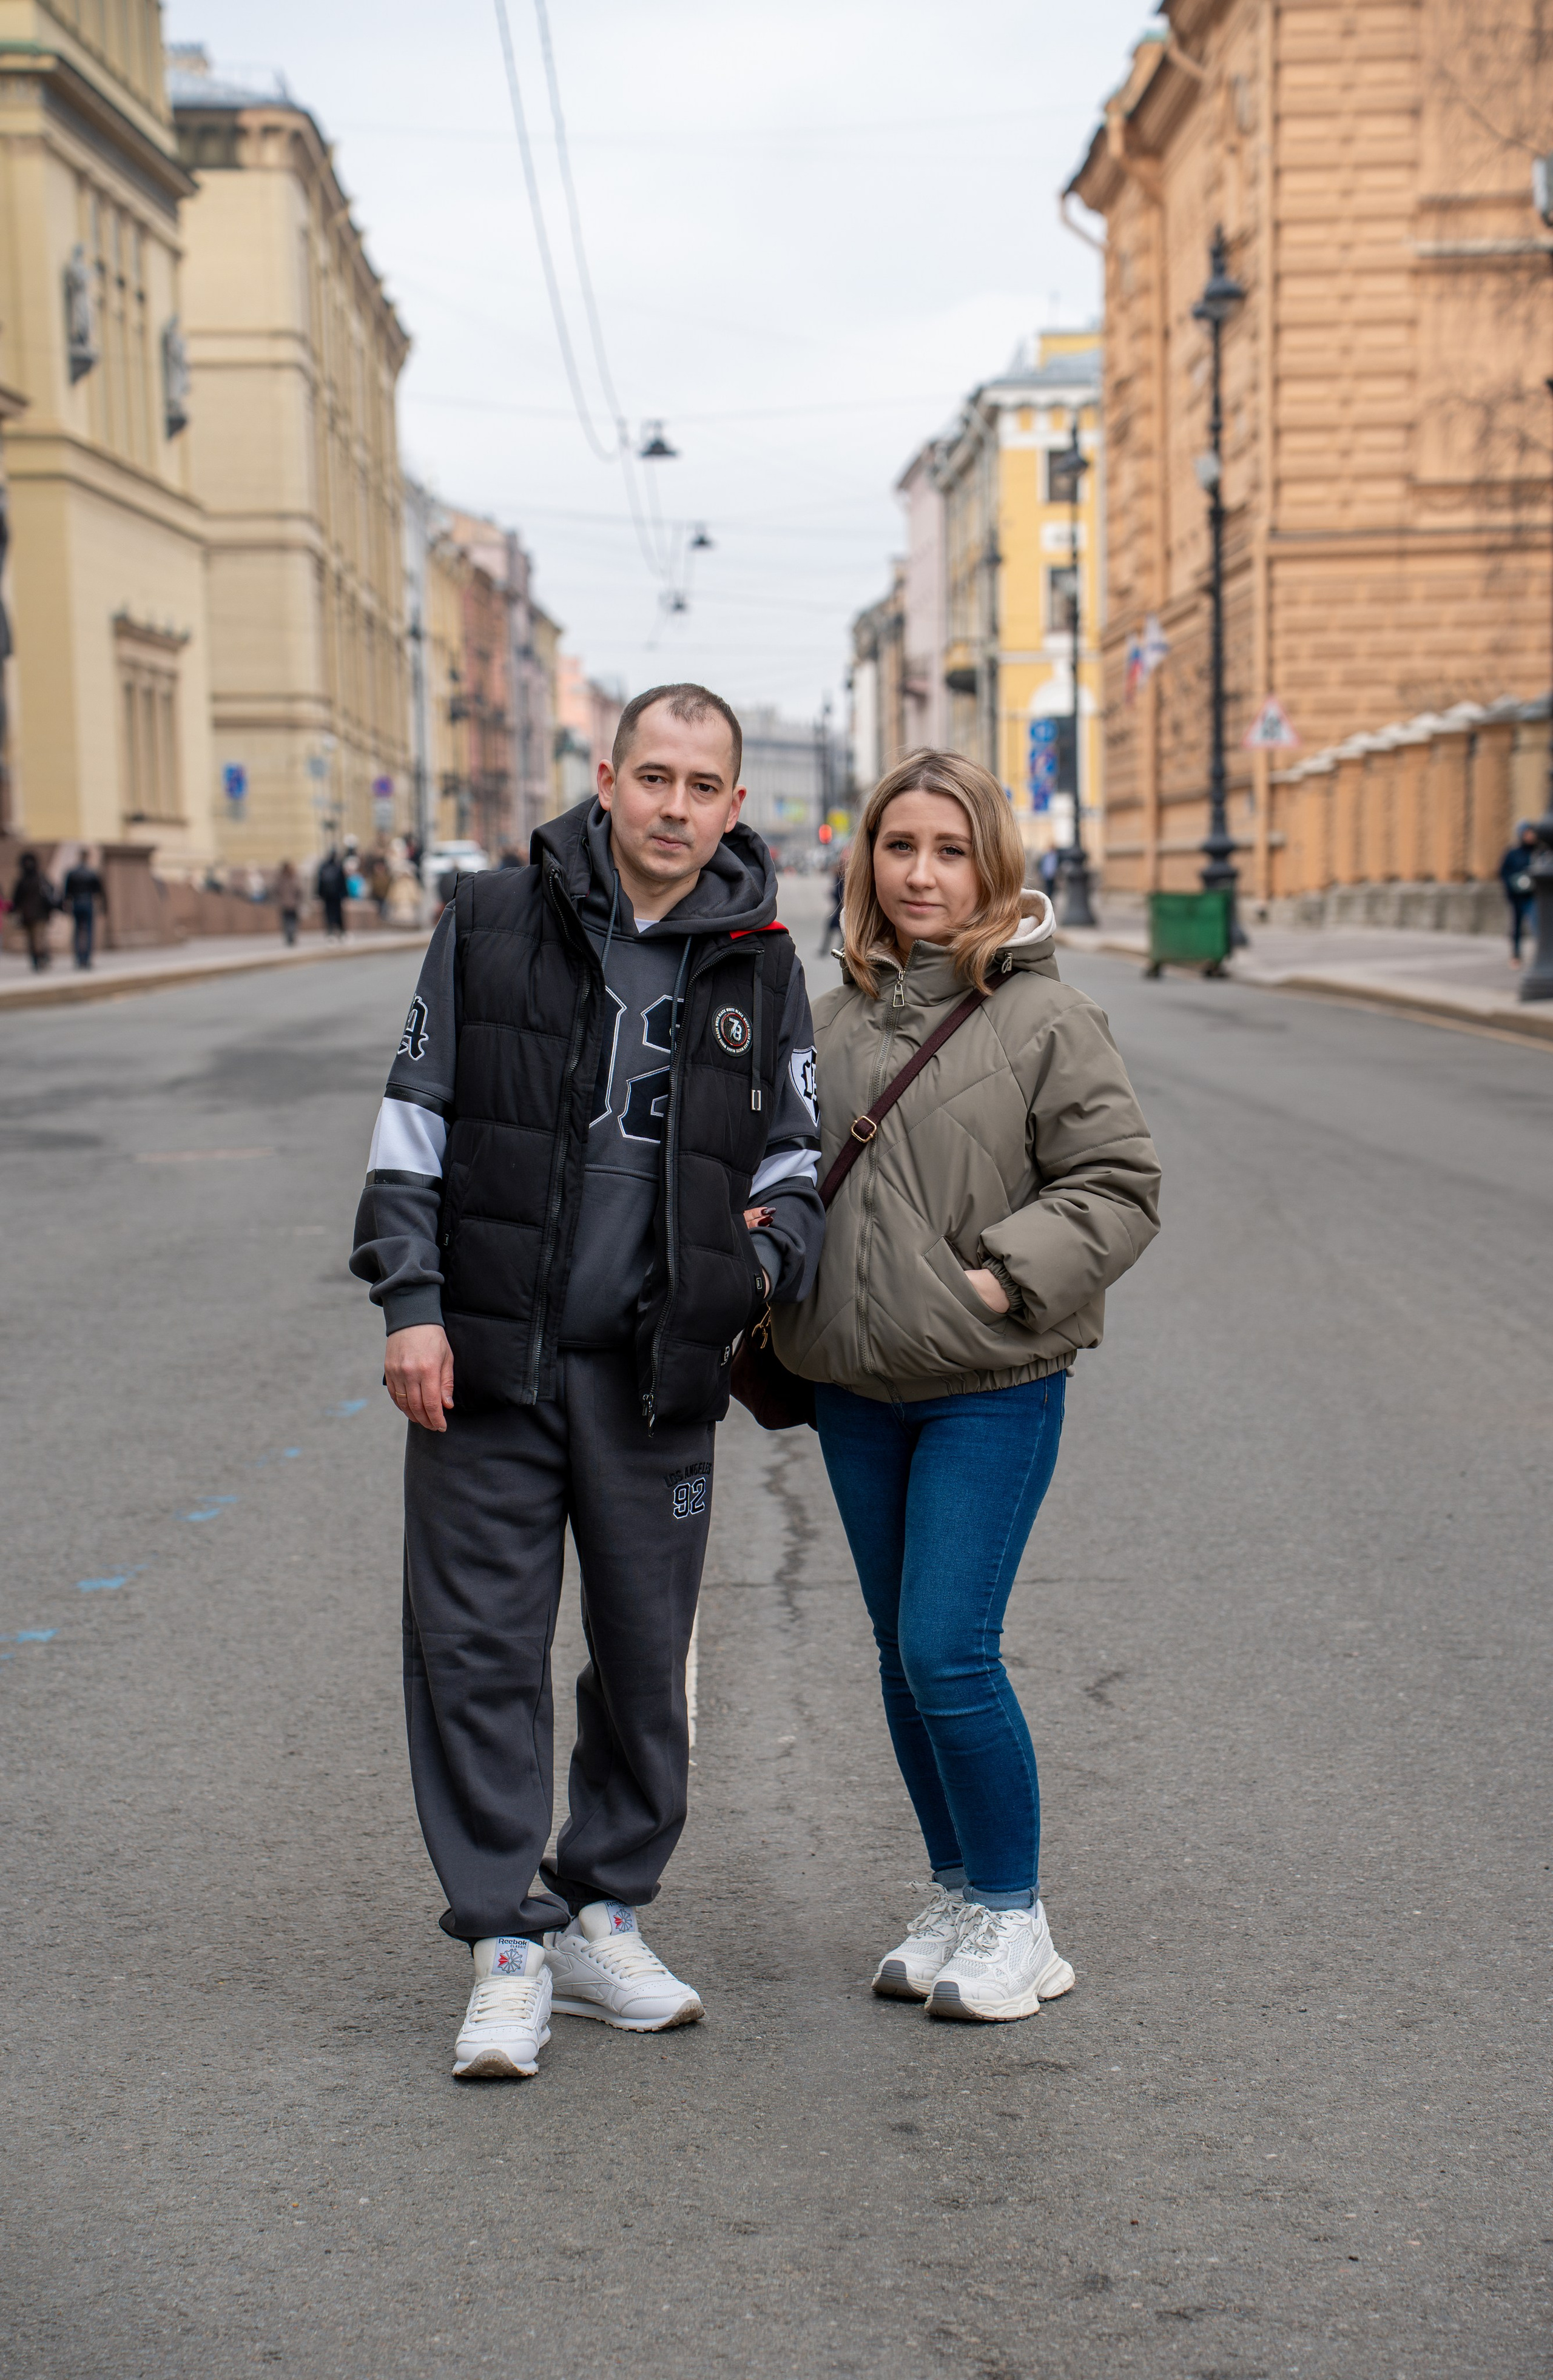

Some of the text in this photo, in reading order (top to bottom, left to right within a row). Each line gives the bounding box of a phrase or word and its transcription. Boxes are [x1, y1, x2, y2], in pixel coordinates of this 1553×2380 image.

[729, 1017, 742, 1041] 78
[664, 1462, 712, 1487] LOS ANGELES
[673, 1477, 706, 1519] 92
